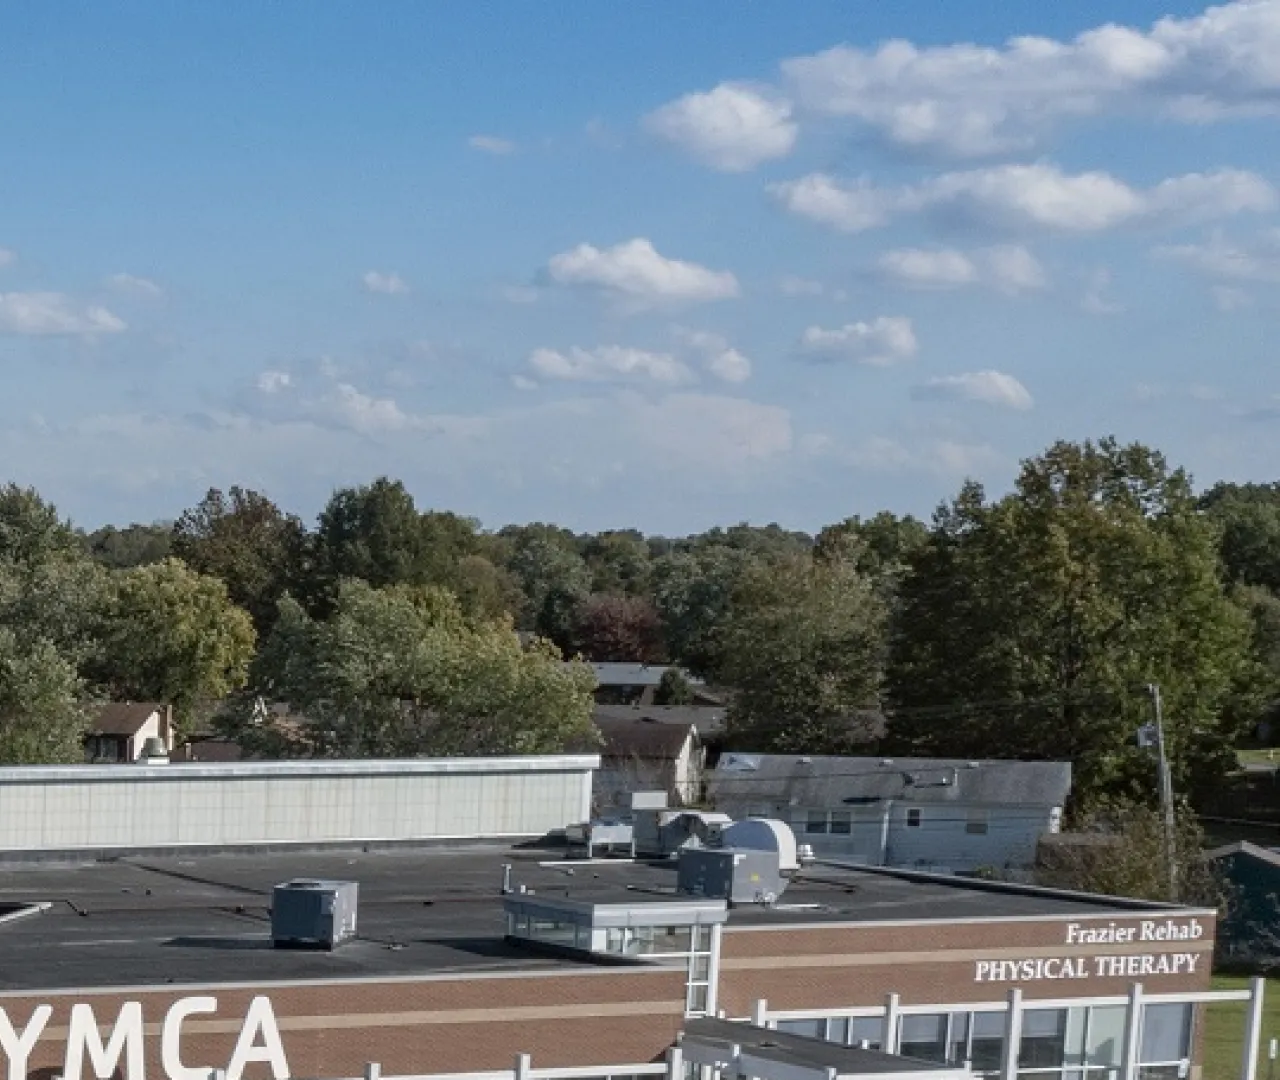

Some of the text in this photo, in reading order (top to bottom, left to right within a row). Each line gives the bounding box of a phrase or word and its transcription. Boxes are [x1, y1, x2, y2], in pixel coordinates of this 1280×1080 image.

[1065, 919, 1203, 944] Frazier Rehab
[974, 953, 1200, 981] PHYSICAL THERAPY
